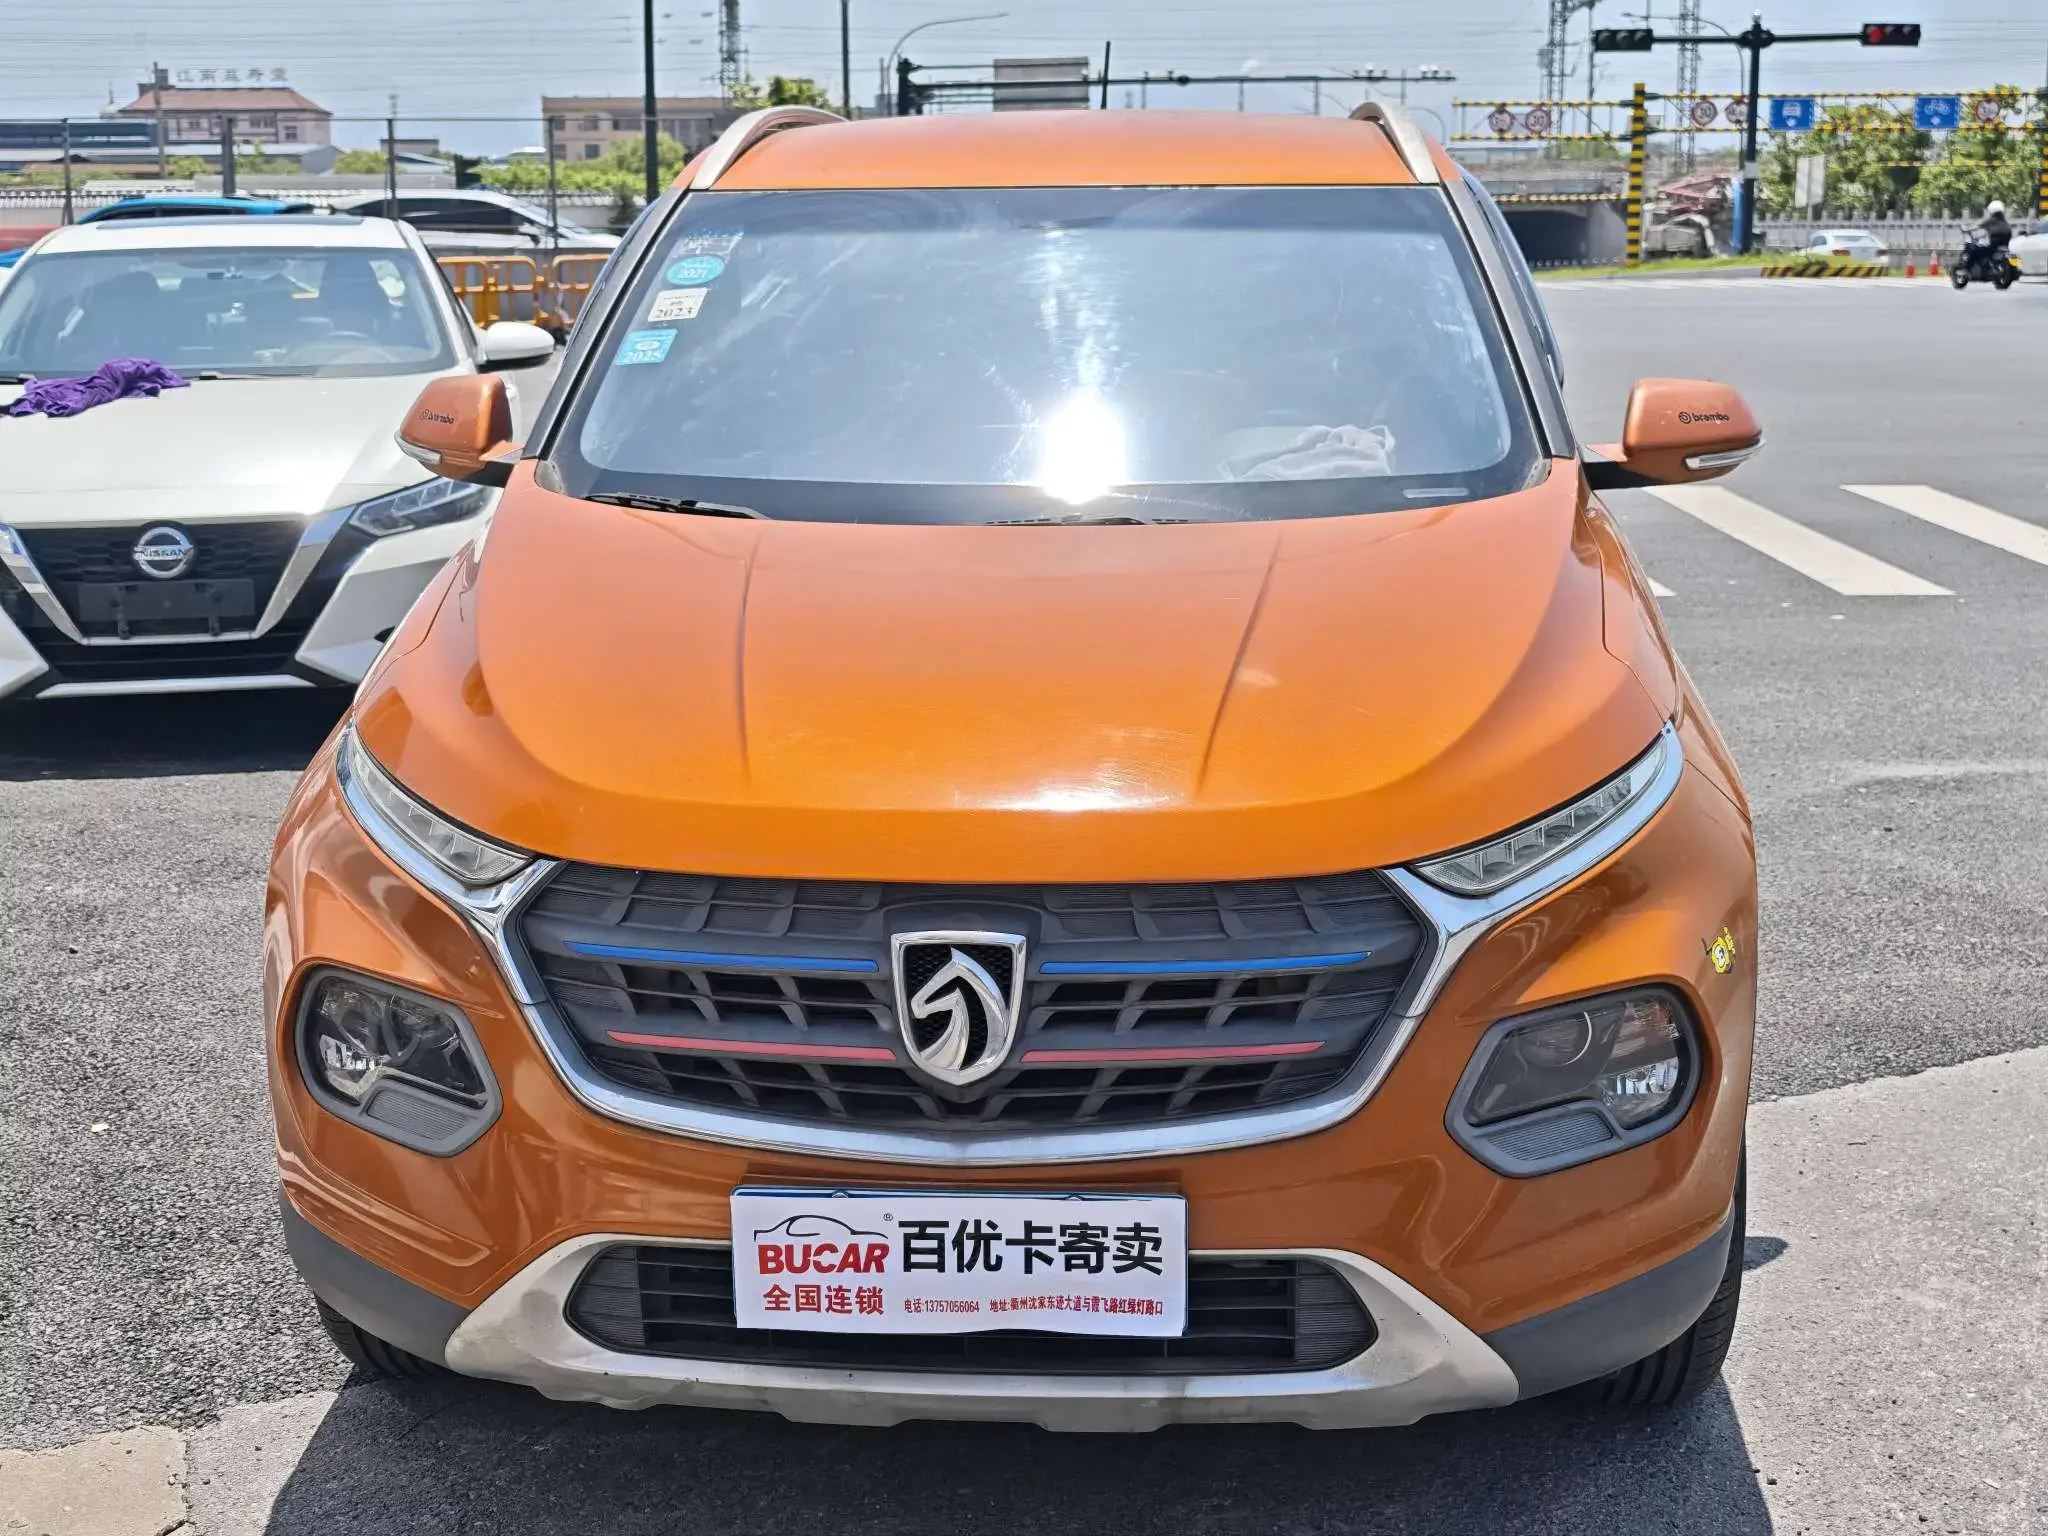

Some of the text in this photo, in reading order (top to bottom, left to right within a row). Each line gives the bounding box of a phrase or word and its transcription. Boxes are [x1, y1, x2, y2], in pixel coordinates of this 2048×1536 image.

[1692, 411, 1730, 422] brembo
[142, 549, 185, 558] NISSAN
[757, 1243, 890, 1275] BUCAR
[898, 1218, 1164, 1276] 百优卡寄卖
[763, 1283, 885, 1316] 全国连锁
[903, 1298, 980, 1314] 电话:13757056064
